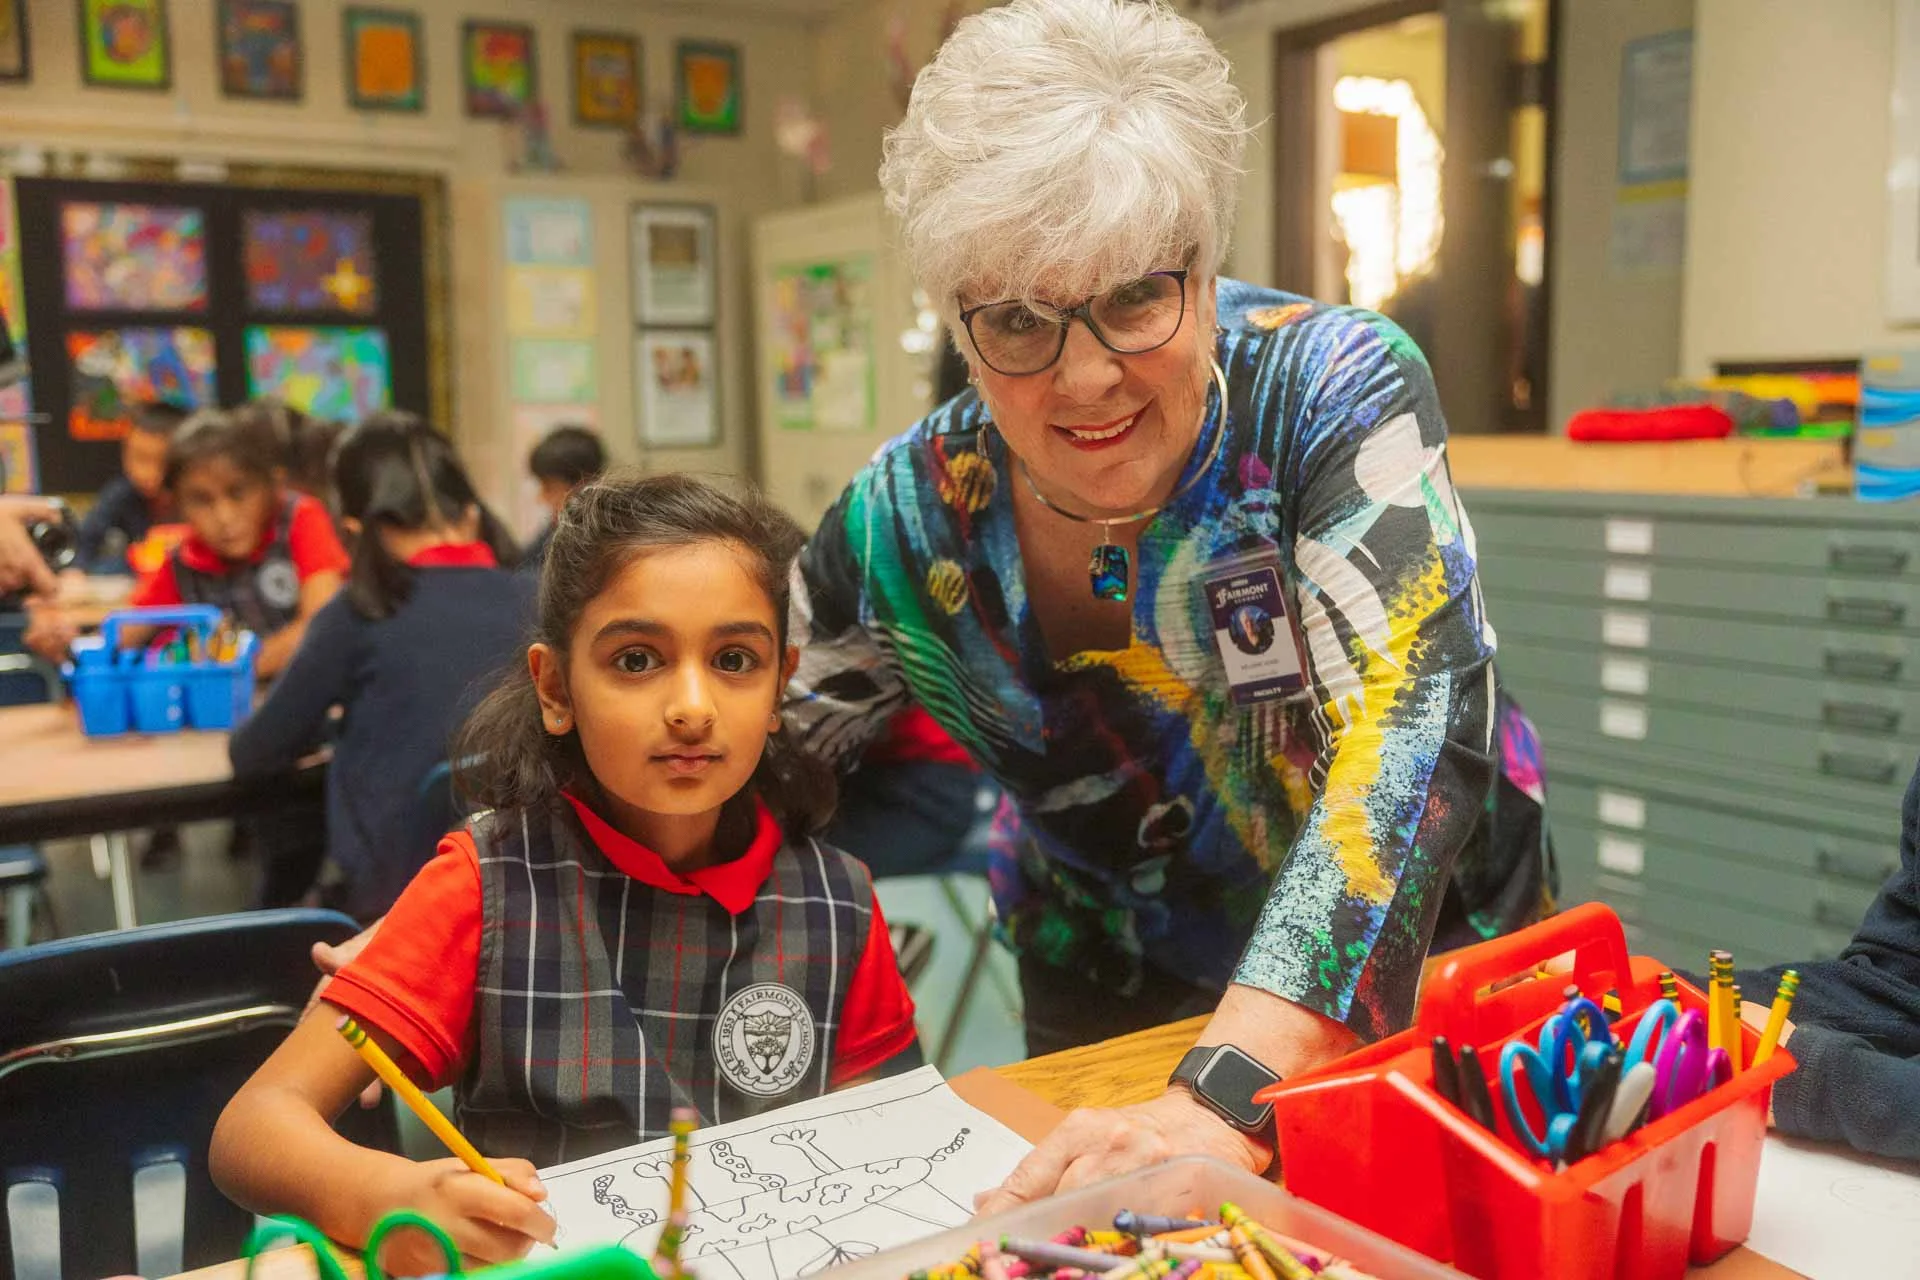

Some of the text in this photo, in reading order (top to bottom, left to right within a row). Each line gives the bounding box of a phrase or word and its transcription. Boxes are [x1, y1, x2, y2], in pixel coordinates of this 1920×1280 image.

[1216, 583, 1269, 608] FAIRMONT
[722, 1017, 735, 1039] 1953
[738, 990, 810, 1065] FAIRMONT SCHOOLS
